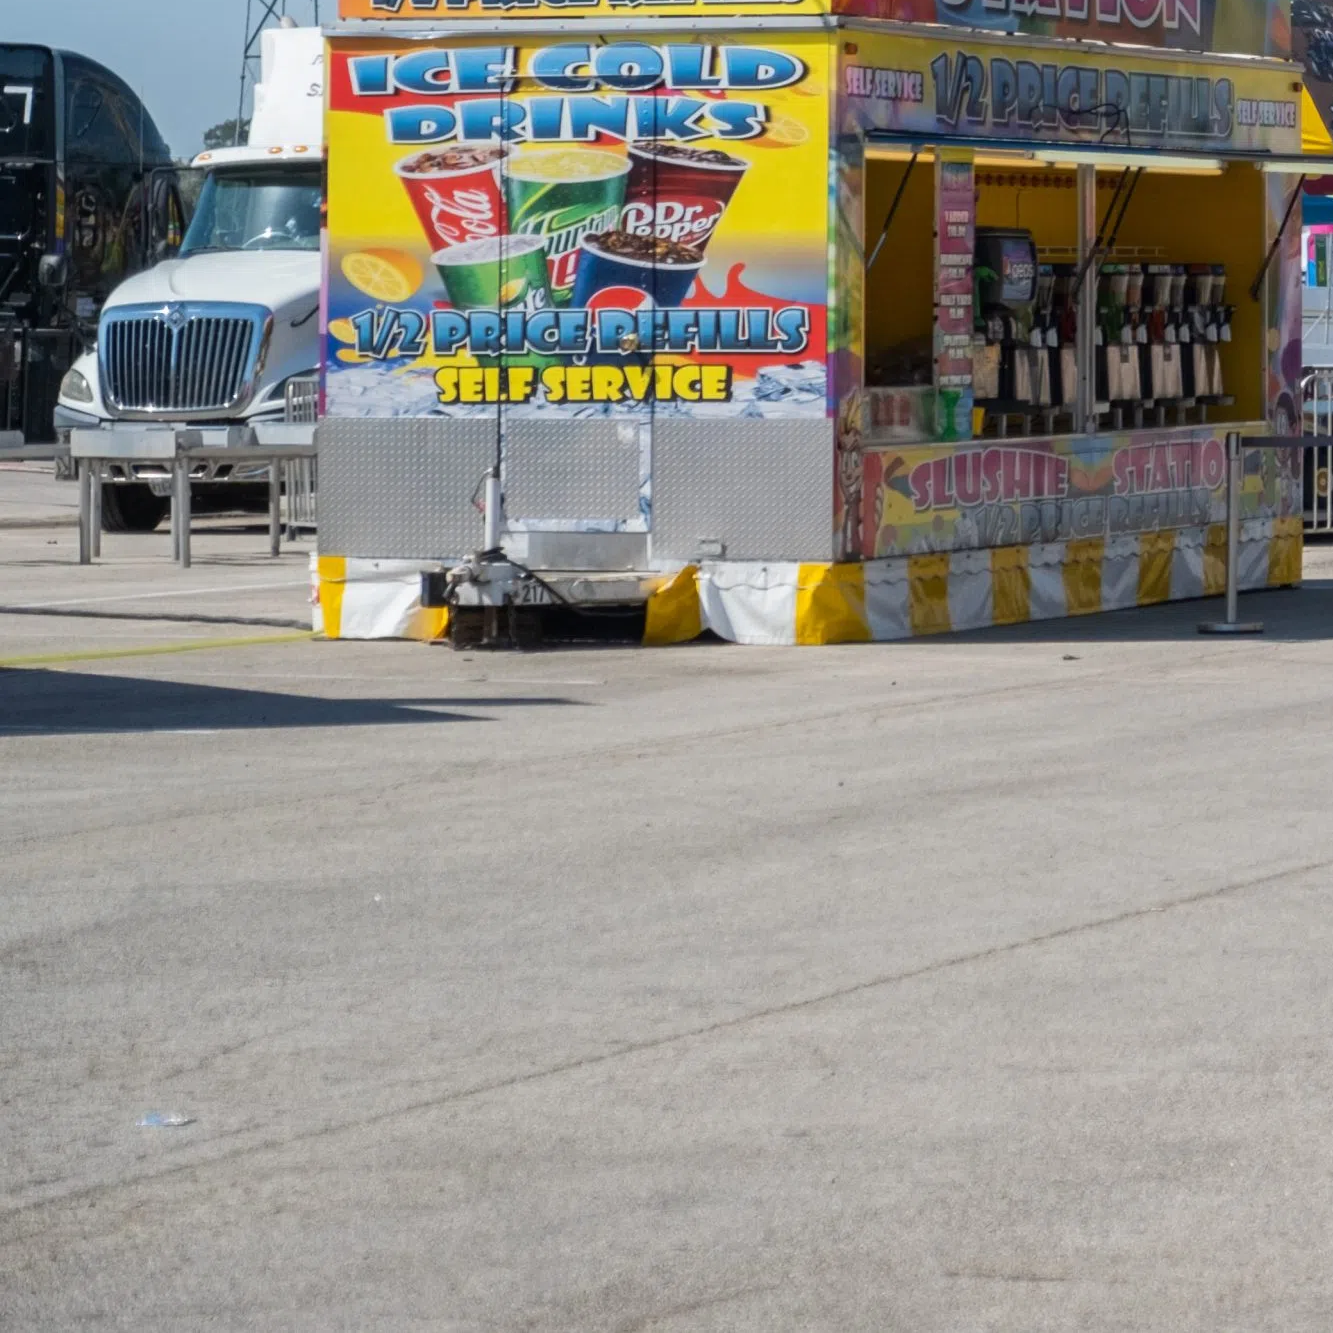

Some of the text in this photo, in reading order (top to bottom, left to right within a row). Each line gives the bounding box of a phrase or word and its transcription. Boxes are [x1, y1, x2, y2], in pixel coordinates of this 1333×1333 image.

[348, 41, 806, 96] ICE COLD
[846, 66, 924, 103] SELF SERVICE
[931, 50, 1234, 138] 1/2 PRICE REFILLS
[1237, 98, 1297, 128] SELF SERVICE
[385, 96, 768, 144] DRINKS
[655, 201, 704, 225] Dr
[352, 306, 810, 358] 1/2 PRICE REFILLS
[433, 364, 733, 404] SELF SERVICE
[908, 439, 1229, 512] SLUSHIE STATIO
[975, 490, 1213, 546] 1/2 PRICE REFILLS
